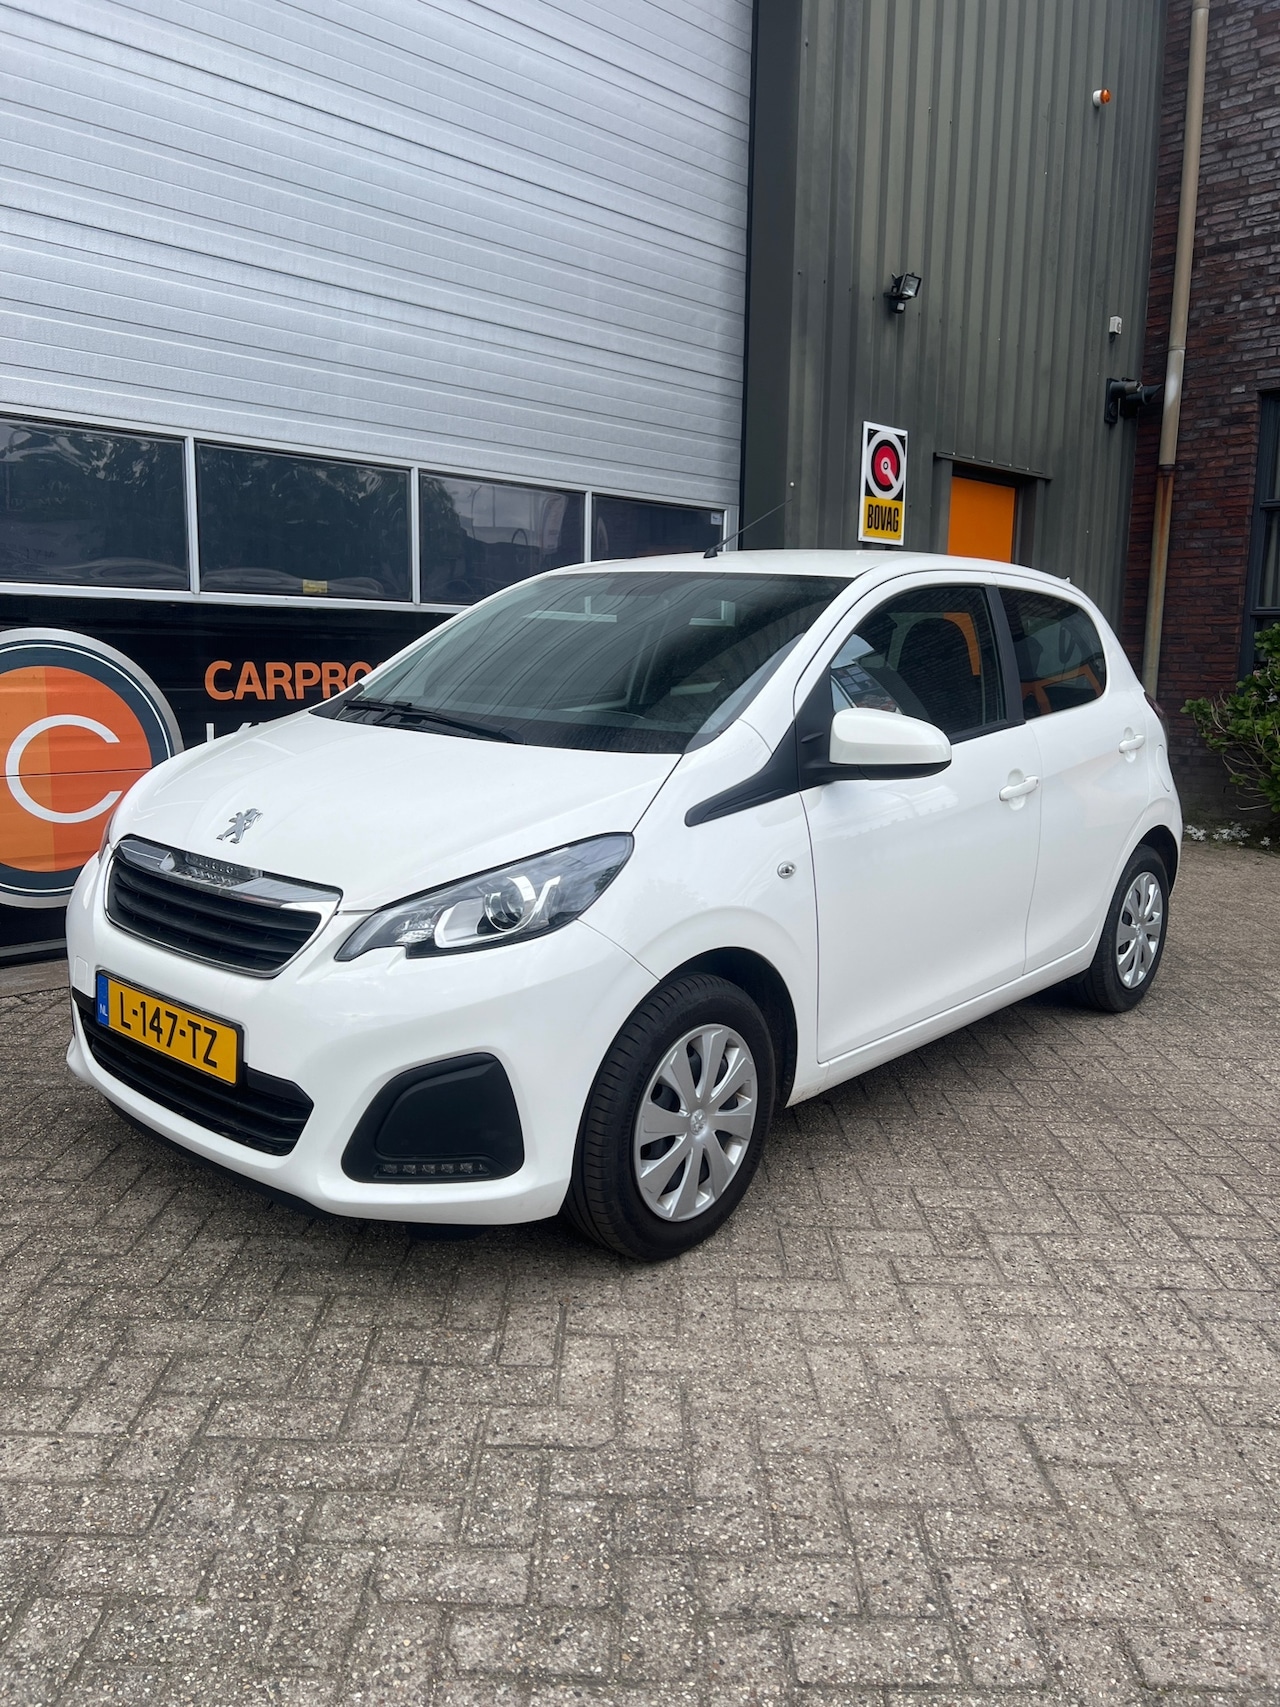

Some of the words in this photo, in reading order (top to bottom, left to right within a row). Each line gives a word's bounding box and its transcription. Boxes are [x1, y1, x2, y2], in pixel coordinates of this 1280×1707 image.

[867, 504, 899, 532] BOVAG
[204, 660, 383, 701] CARPRO
[99, 1003, 108, 1017] NL
[120, 992, 218, 1069] L-147-TZ
